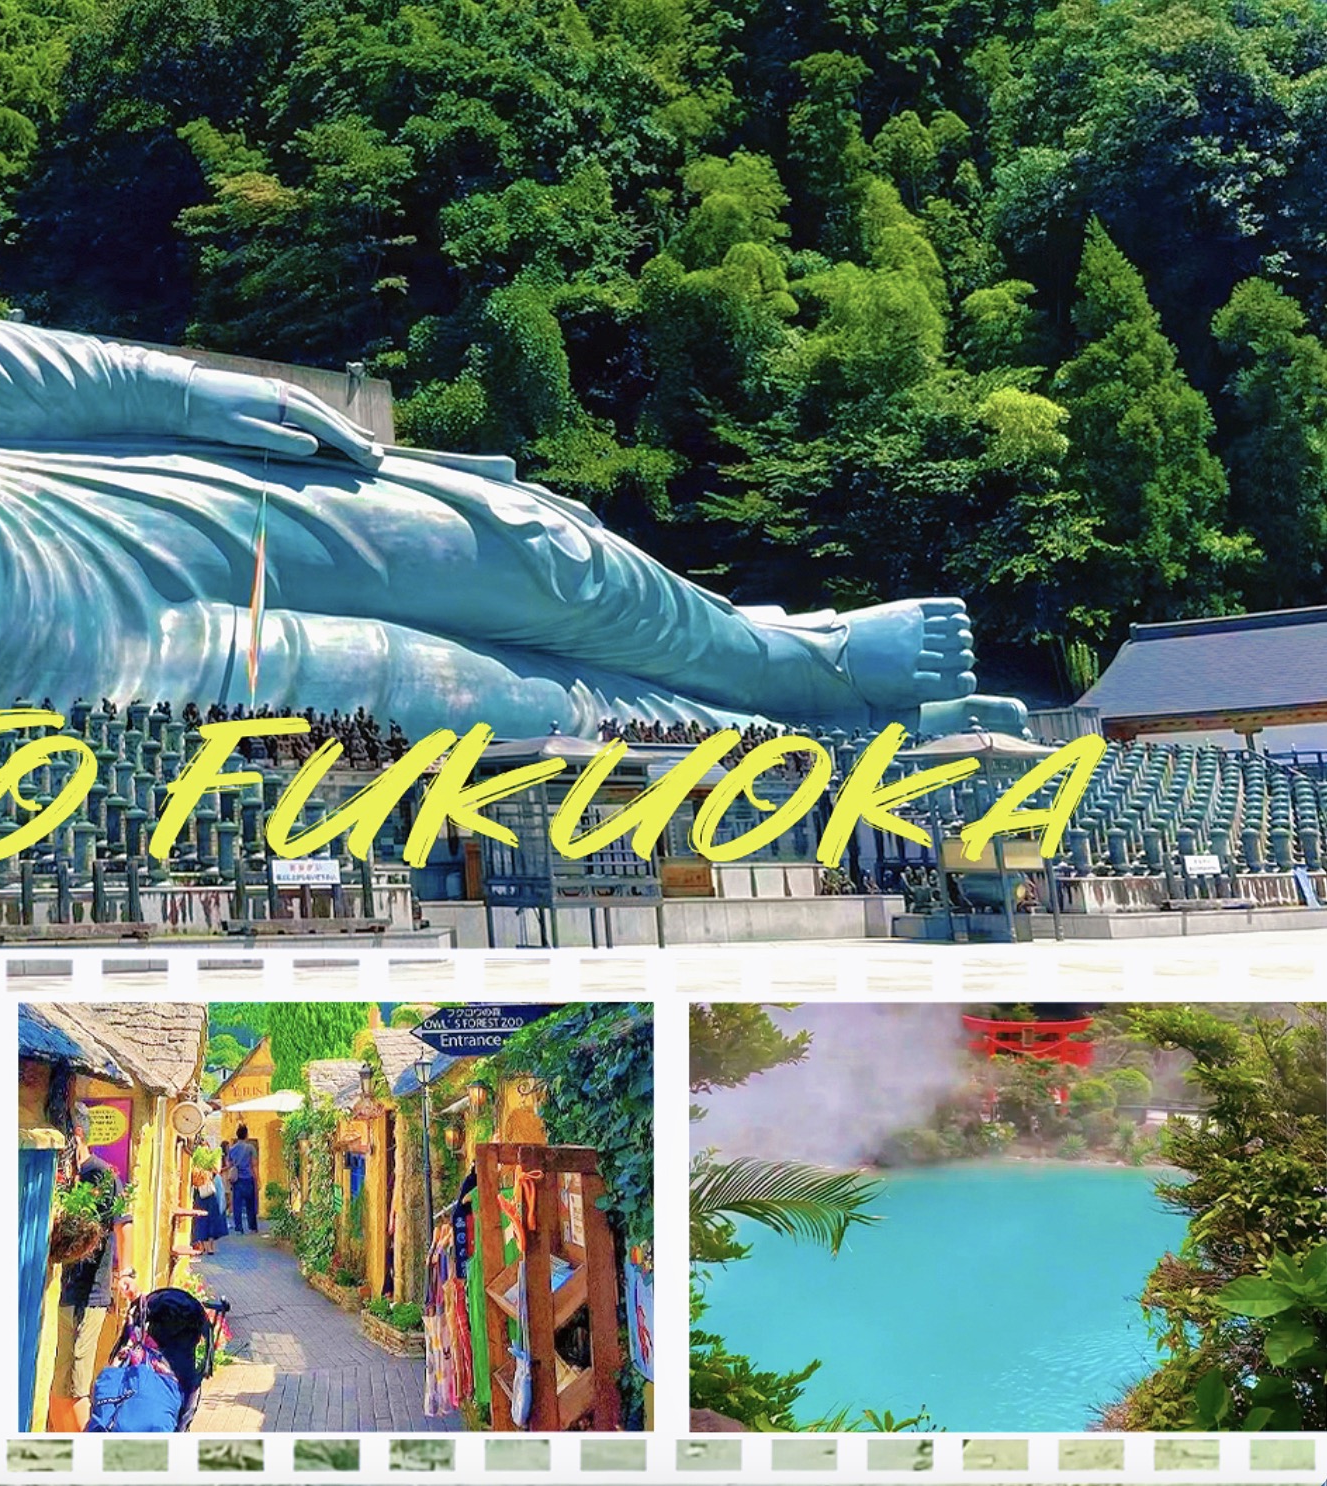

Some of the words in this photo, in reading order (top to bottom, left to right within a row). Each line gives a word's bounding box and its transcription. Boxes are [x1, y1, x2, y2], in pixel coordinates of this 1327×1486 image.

[447, 1007, 502, 1017] フクロウの森
[462, 1018, 499, 1029] FOREST
[501, 1017, 524, 1028] ZOO
[440, 1033, 502, 1047] Entrance
